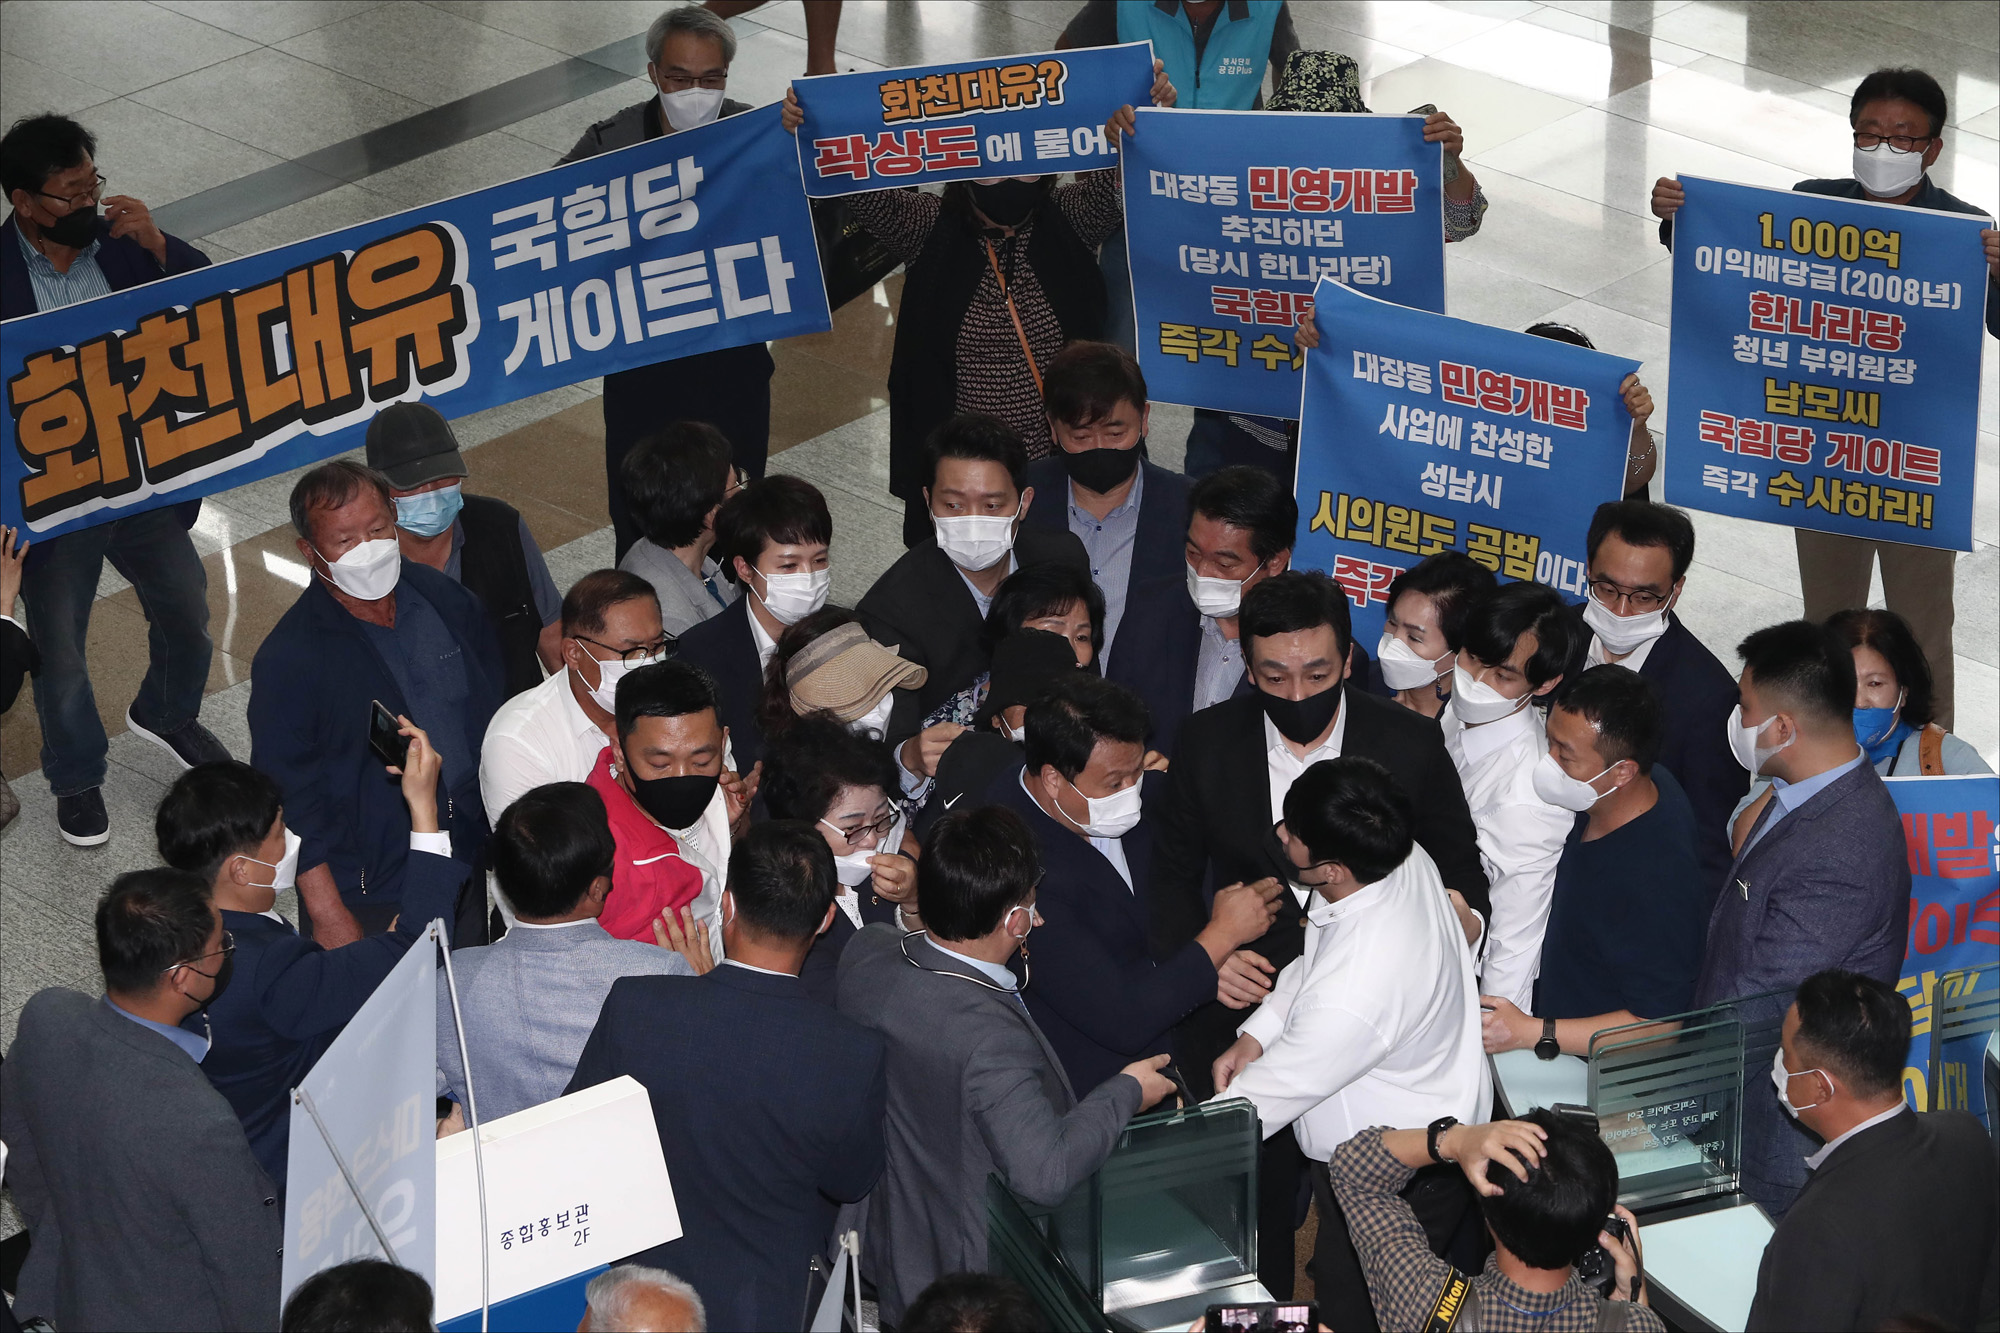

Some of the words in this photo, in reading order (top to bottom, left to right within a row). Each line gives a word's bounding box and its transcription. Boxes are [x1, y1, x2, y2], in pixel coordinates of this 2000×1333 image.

[879, 60, 1067, 124] 화천대유?
[1218, 66, 1253, 75] 공감Plus
[490, 156, 704, 272] 국힘당
[1150, 169, 1239, 206] 대장동
[1248, 166, 1418, 214] 민영개발
[1221, 215, 1344, 248] 추진하던
[1758, 212, 1902, 270] 1.000억
[1178, 244, 1250, 278] (당시
[1258, 254, 1392, 286] 한나라당)
[1695, 245, 1962, 311] 이익배당금(2008년)
[498, 235, 796, 377] 게이트다
[1749, 290, 1907, 353] 한나라당
[10, 224, 473, 520] 화천대유
[1158, 321, 1242, 367] 즉각
[1251, 333, 1305, 372] 수
[1733, 334, 1789, 369] 청년
[1800, 344, 1917, 385] 부위원장
[1352, 350, 1432, 394] 대장동
[1439, 360, 1591, 433] 민영개발
[1764, 377, 1882, 429] 남모씨
[1378, 403, 1463, 452] 사업에
[1470, 421, 1553, 470] 찬성한
[1699, 409, 1815, 465] 국힘당
[1824, 430, 1941, 487] 게이트
[1420, 461, 1504, 510] 성남시
[1702, 464, 1759, 499] 즉각
[1767, 470, 1934, 530] 수사하라!
[1309, 490, 1457, 559] 시의원도
[499, 1202, 590, 1251] 종합홍보관
[573, 1229, 591, 1248] 2F
[1436, 1279, 1465, 1323] Nikon
